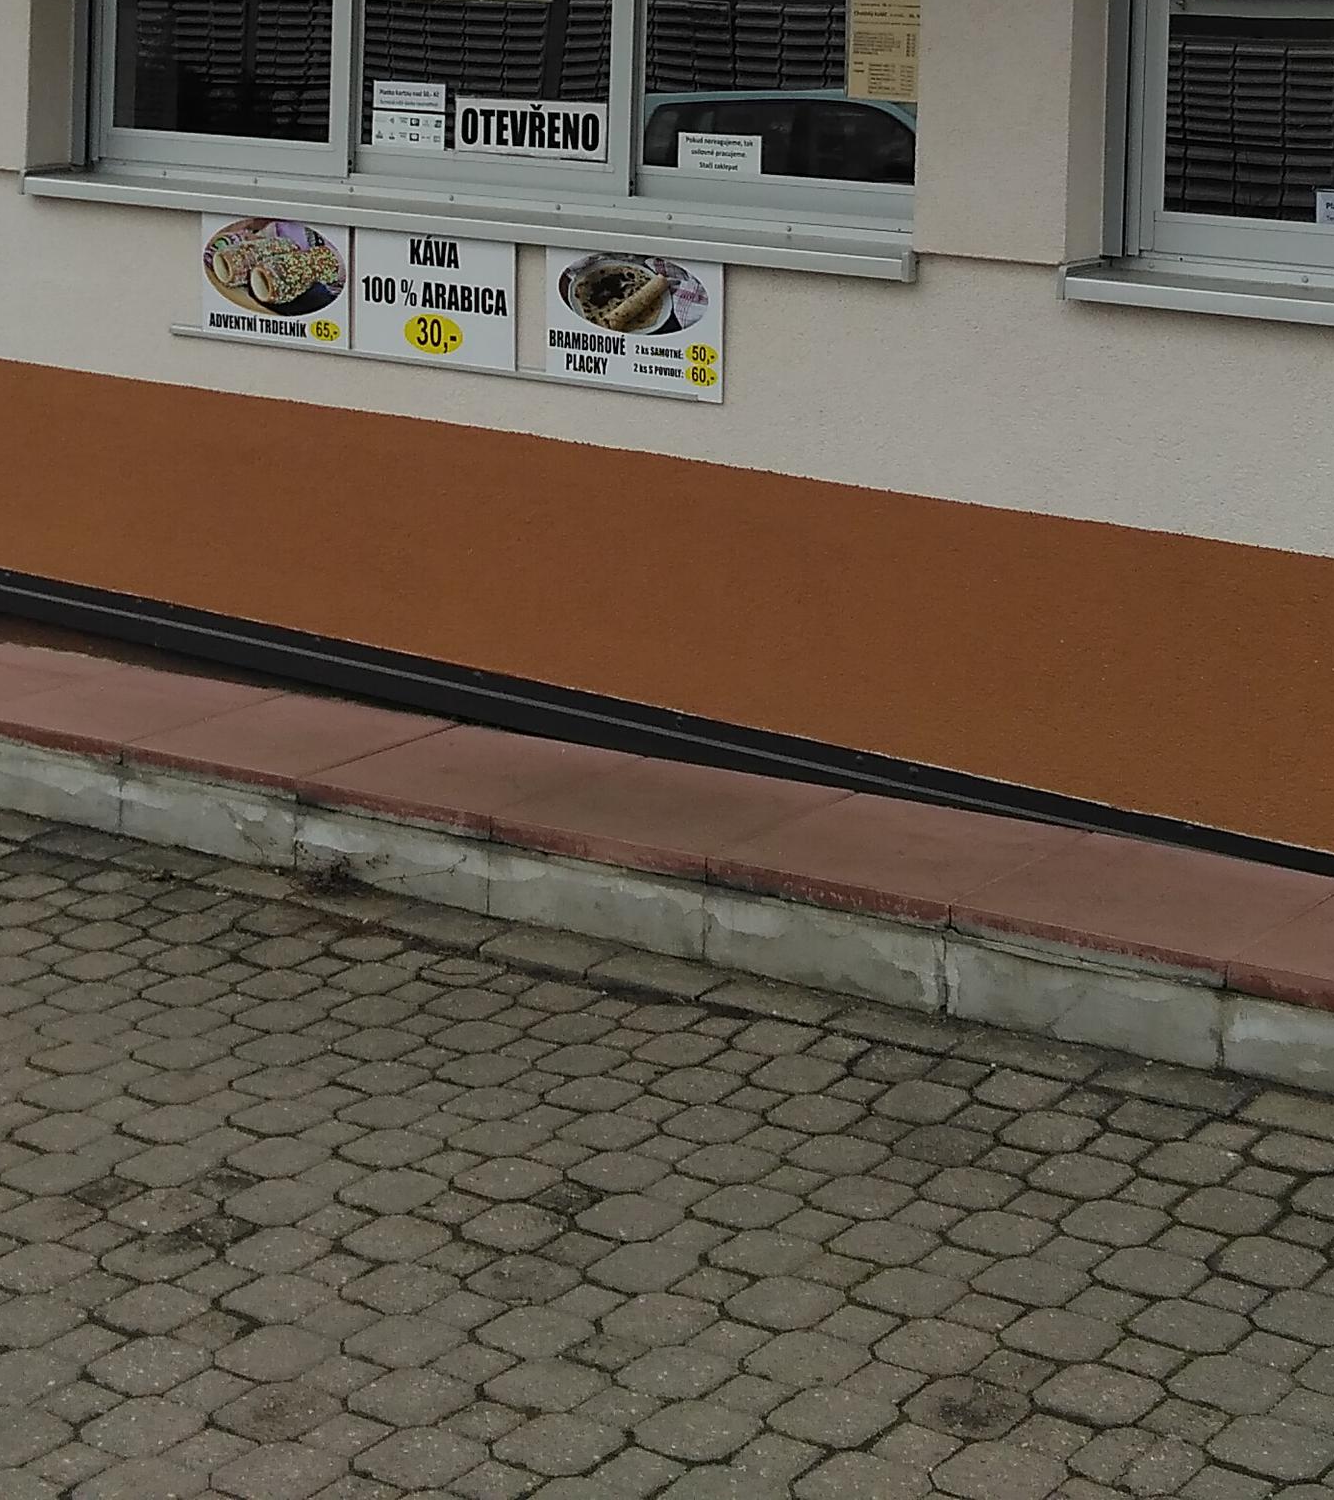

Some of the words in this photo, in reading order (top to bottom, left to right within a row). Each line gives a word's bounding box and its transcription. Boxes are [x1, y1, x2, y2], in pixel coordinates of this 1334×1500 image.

[461, 103, 600, 151] OTEVŘENO
[409, 235, 460, 269] KÁVA
[362, 275, 396, 305] 100
[401, 281, 418, 307] %
[421, 281, 509, 317] ARABICA
[209, 312, 258, 333] ADVENTNÍ
[259, 317, 308, 338] TRDELNÍK
[315, 321, 339, 341] 65,-
[416, 316, 458, 354] 30,-
[549, 329, 626, 356] BRAMBOROVÉ
[635, 344, 641, 354] 2
[641, 345, 650, 355] ks
[691, 346, 716, 365] 50,-
[566, 353, 609, 375] PLACKY
[633, 363, 639, 372] 2
[639, 364, 648, 374] ks
[648, 365, 654, 374] S
[691, 366, 716, 386] 60,-
